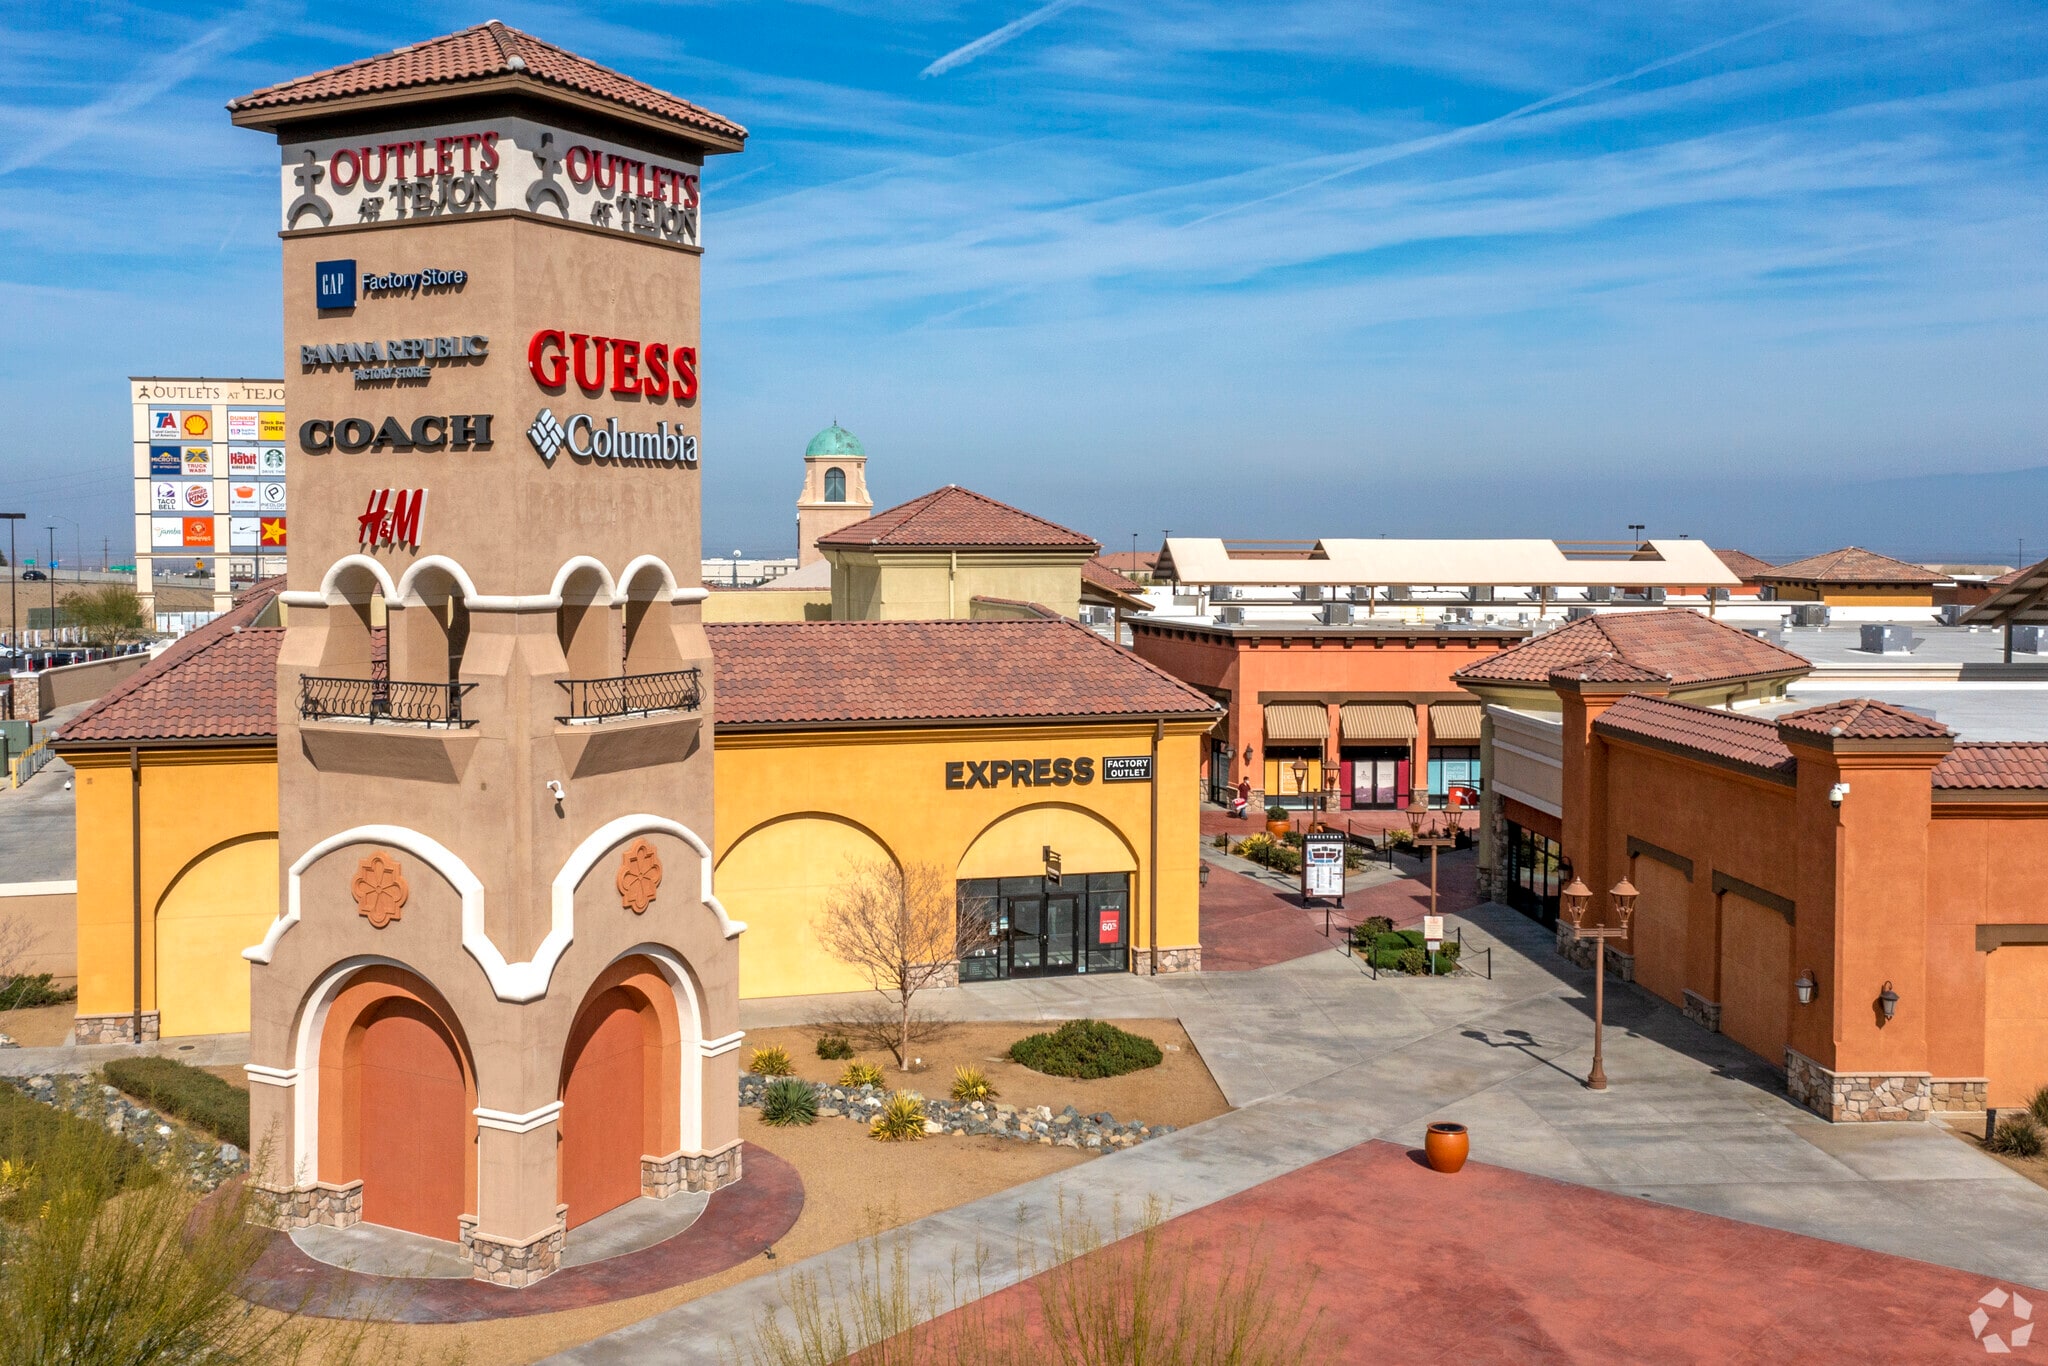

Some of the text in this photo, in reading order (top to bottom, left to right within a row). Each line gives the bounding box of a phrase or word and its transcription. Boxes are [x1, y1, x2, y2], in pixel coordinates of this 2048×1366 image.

[329, 131, 499, 187] OUTLETS
[566, 145, 699, 209] OUTLETS
[358, 174, 498, 216] AT TEJON
[619, 197, 698, 238] TEJON
[322, 268, 465, 295] GAP Factory Store
[300, 335, 489, 365] BANANA REPUBLIC
[528, 330, 698, 399] GUESS
[353, 366, 432, 381] FACTORY STORE
[153, 386, 285, 400] OUTLETS AT TEJO
[156, 412, 177, 428] TA
[299, 414, 494, 449] COACH
[563, 413, 698, 462] Columbia
[230, 453, 256, 464] Habit
[188, 492, 208, 502] KING
[358, 488, 428, 547] H&M
[945, 757, 1095, 789] EXPRESS
[1107, 759, 1149, 768] FACTORY
[1110, 768, 1146, 777] OUTLET
